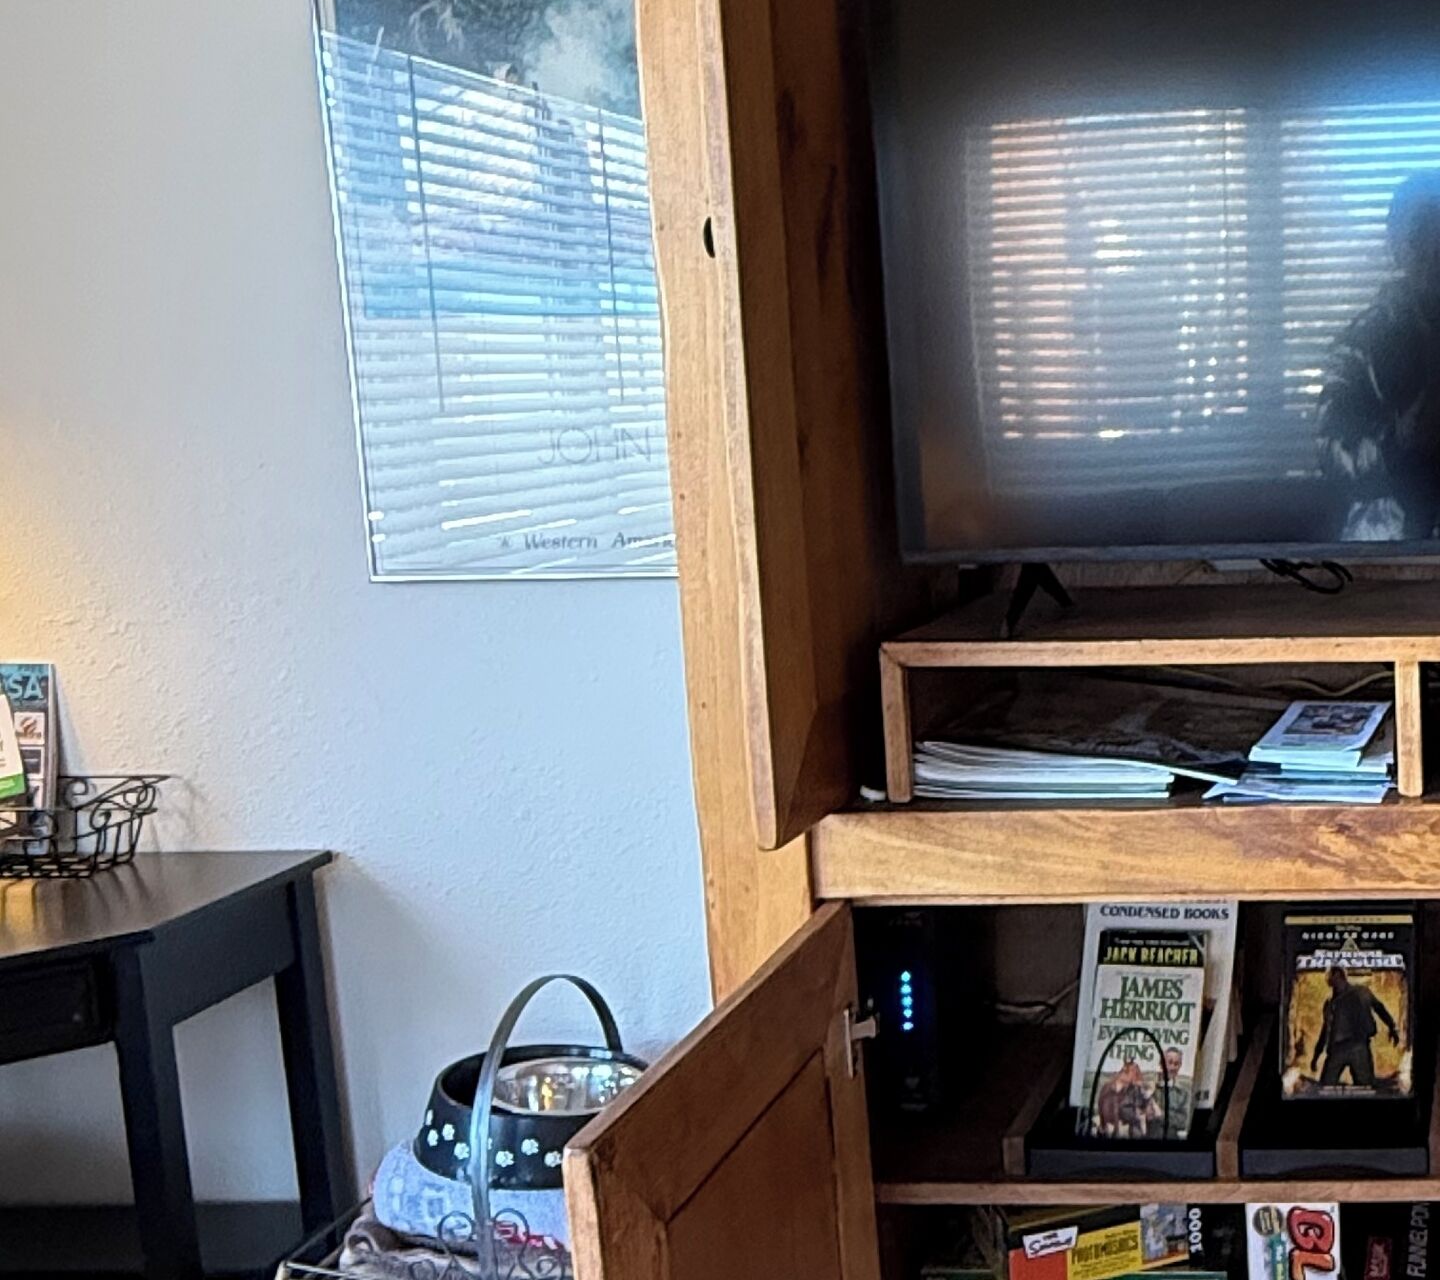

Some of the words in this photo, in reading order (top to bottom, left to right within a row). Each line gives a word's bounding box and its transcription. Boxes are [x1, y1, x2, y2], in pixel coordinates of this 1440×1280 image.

[538, 427, 651, 465] JOHN
[524, 532, 598, 550] Western
[5, 672, 44, 700] SA
[1100, 904, 1180, 920] CONDENSED
[1184, 906, 1229, 920] BOOKS
[1103, 946, 1137, 964] JACK
[1141, 947, 1198, 965] REACHER
[1120, 975, 1184, 1001] JAMES
[1099, 998, 1196, 1023] HERRIOT
[1144, 1028, 1190, 1045] LVING
[1410, 1202, 1430, 1227] PON
[1188, 1208, 1202, 1253] 1000
[1406, 1229, 1429, 1278] FUNNEL
